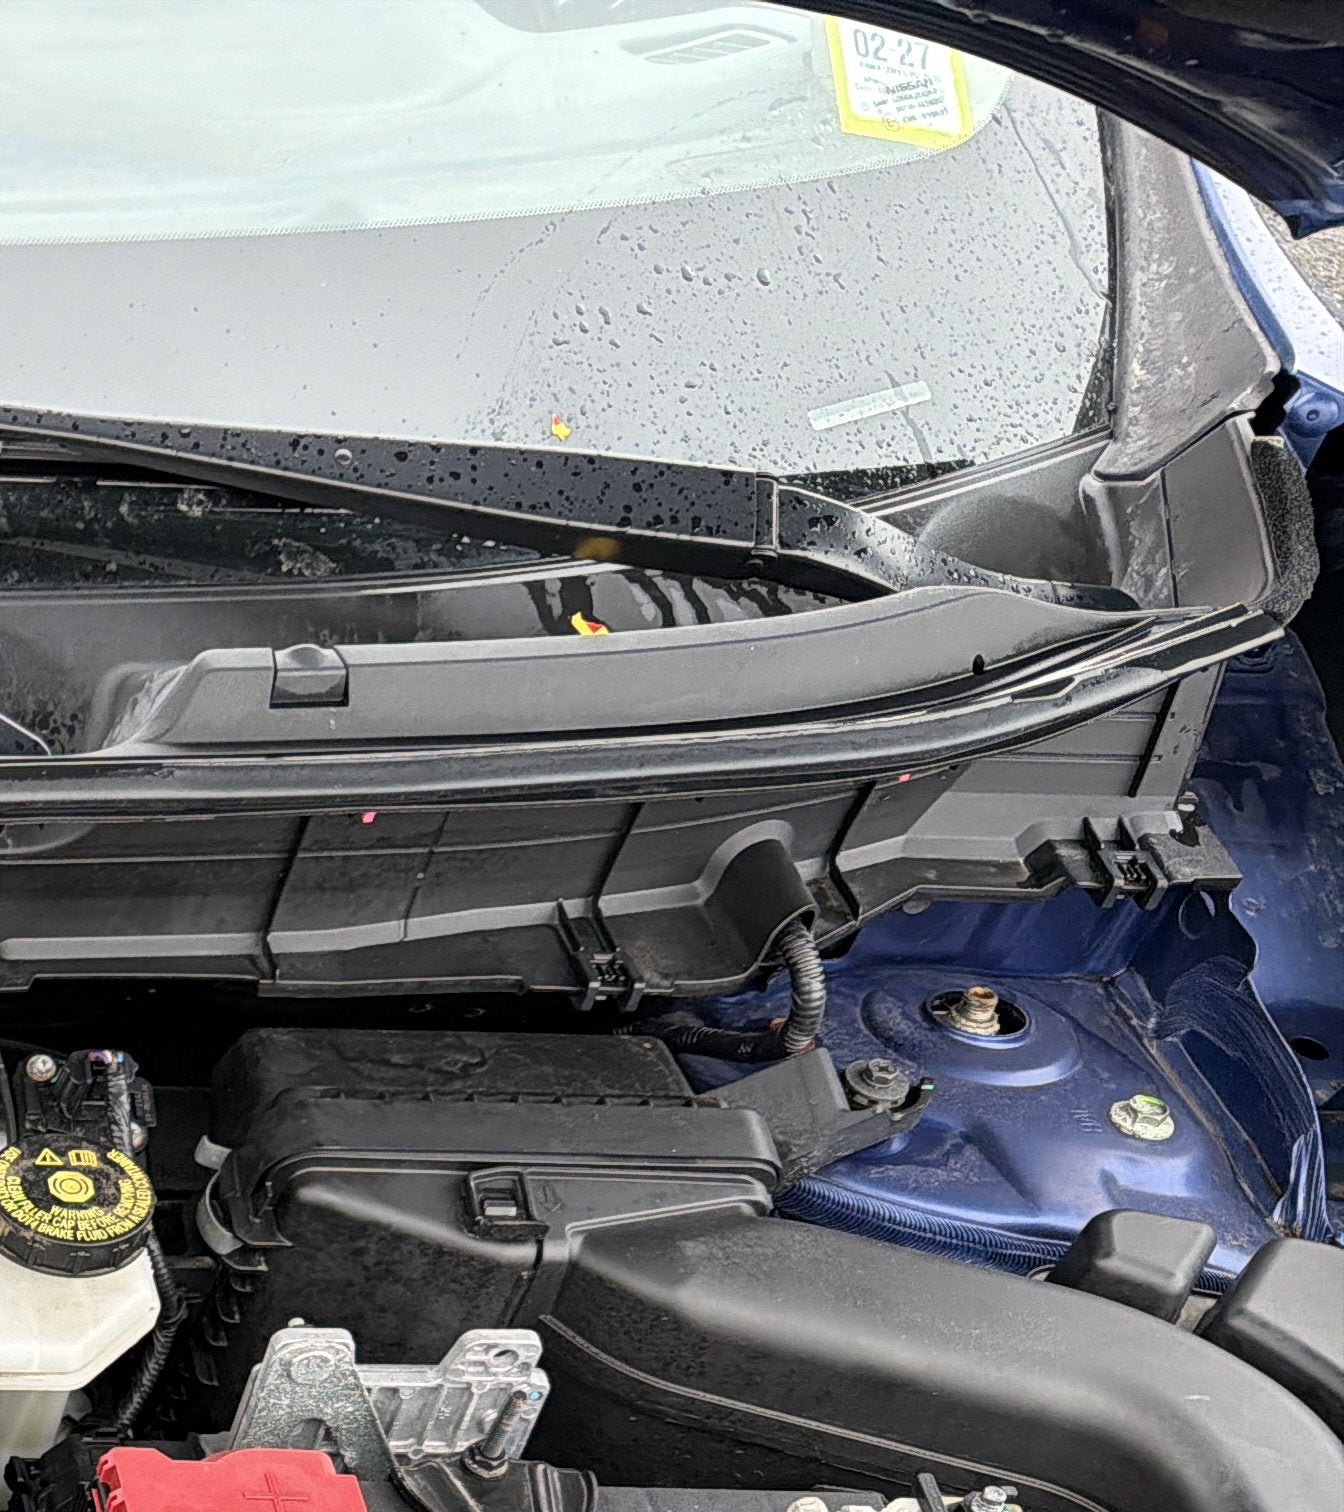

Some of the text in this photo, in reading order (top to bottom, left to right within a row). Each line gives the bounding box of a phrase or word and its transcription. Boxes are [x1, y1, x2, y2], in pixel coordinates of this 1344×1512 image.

[853, 28, 930, 70] 02-27
[17, 1200, 53, 1225] FILLER
[52, 1217, 76, 1231] CAP
[76, 1213, 120, 1231] BEFORE
[50, 1204, 105, 1221] WARNING
[37, 1222, 75, 1241] BRAKE
[76, 1228, 109, 1241] FLUID
[105, 1218, 136, 1238] FROM
